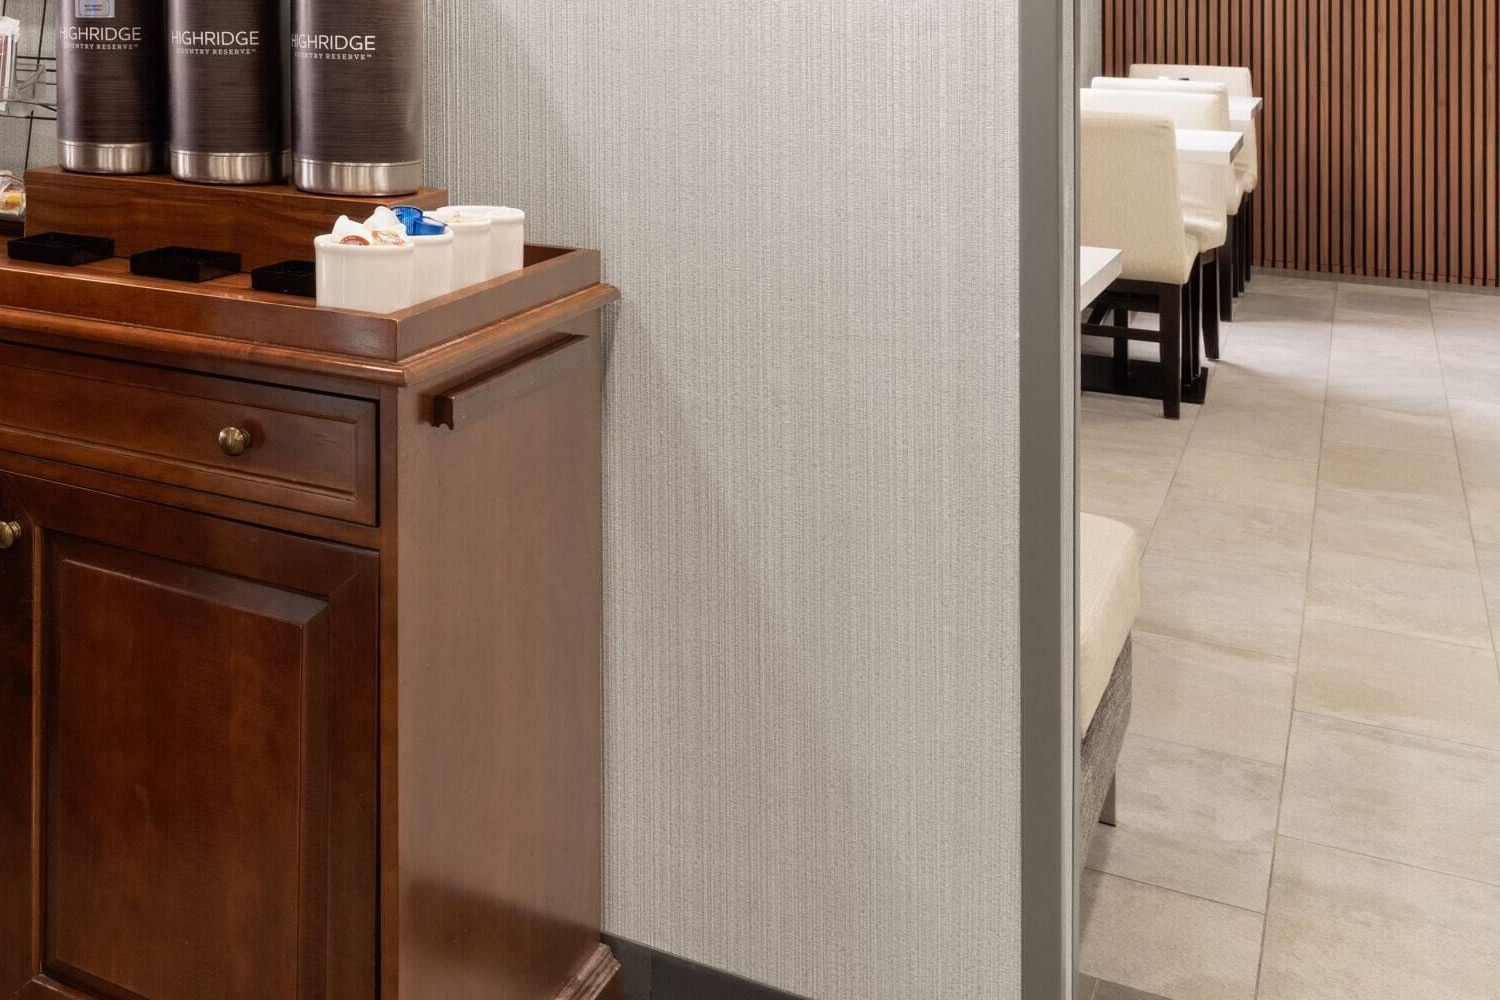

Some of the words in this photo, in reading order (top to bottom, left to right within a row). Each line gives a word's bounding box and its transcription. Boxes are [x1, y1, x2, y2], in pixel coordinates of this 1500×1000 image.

[62, 42, 94, 50] OUNTRY
[171, 30, 260, 46] HIGHRIDGE
[291, 34, 376, 51] HIGHRIDGE
